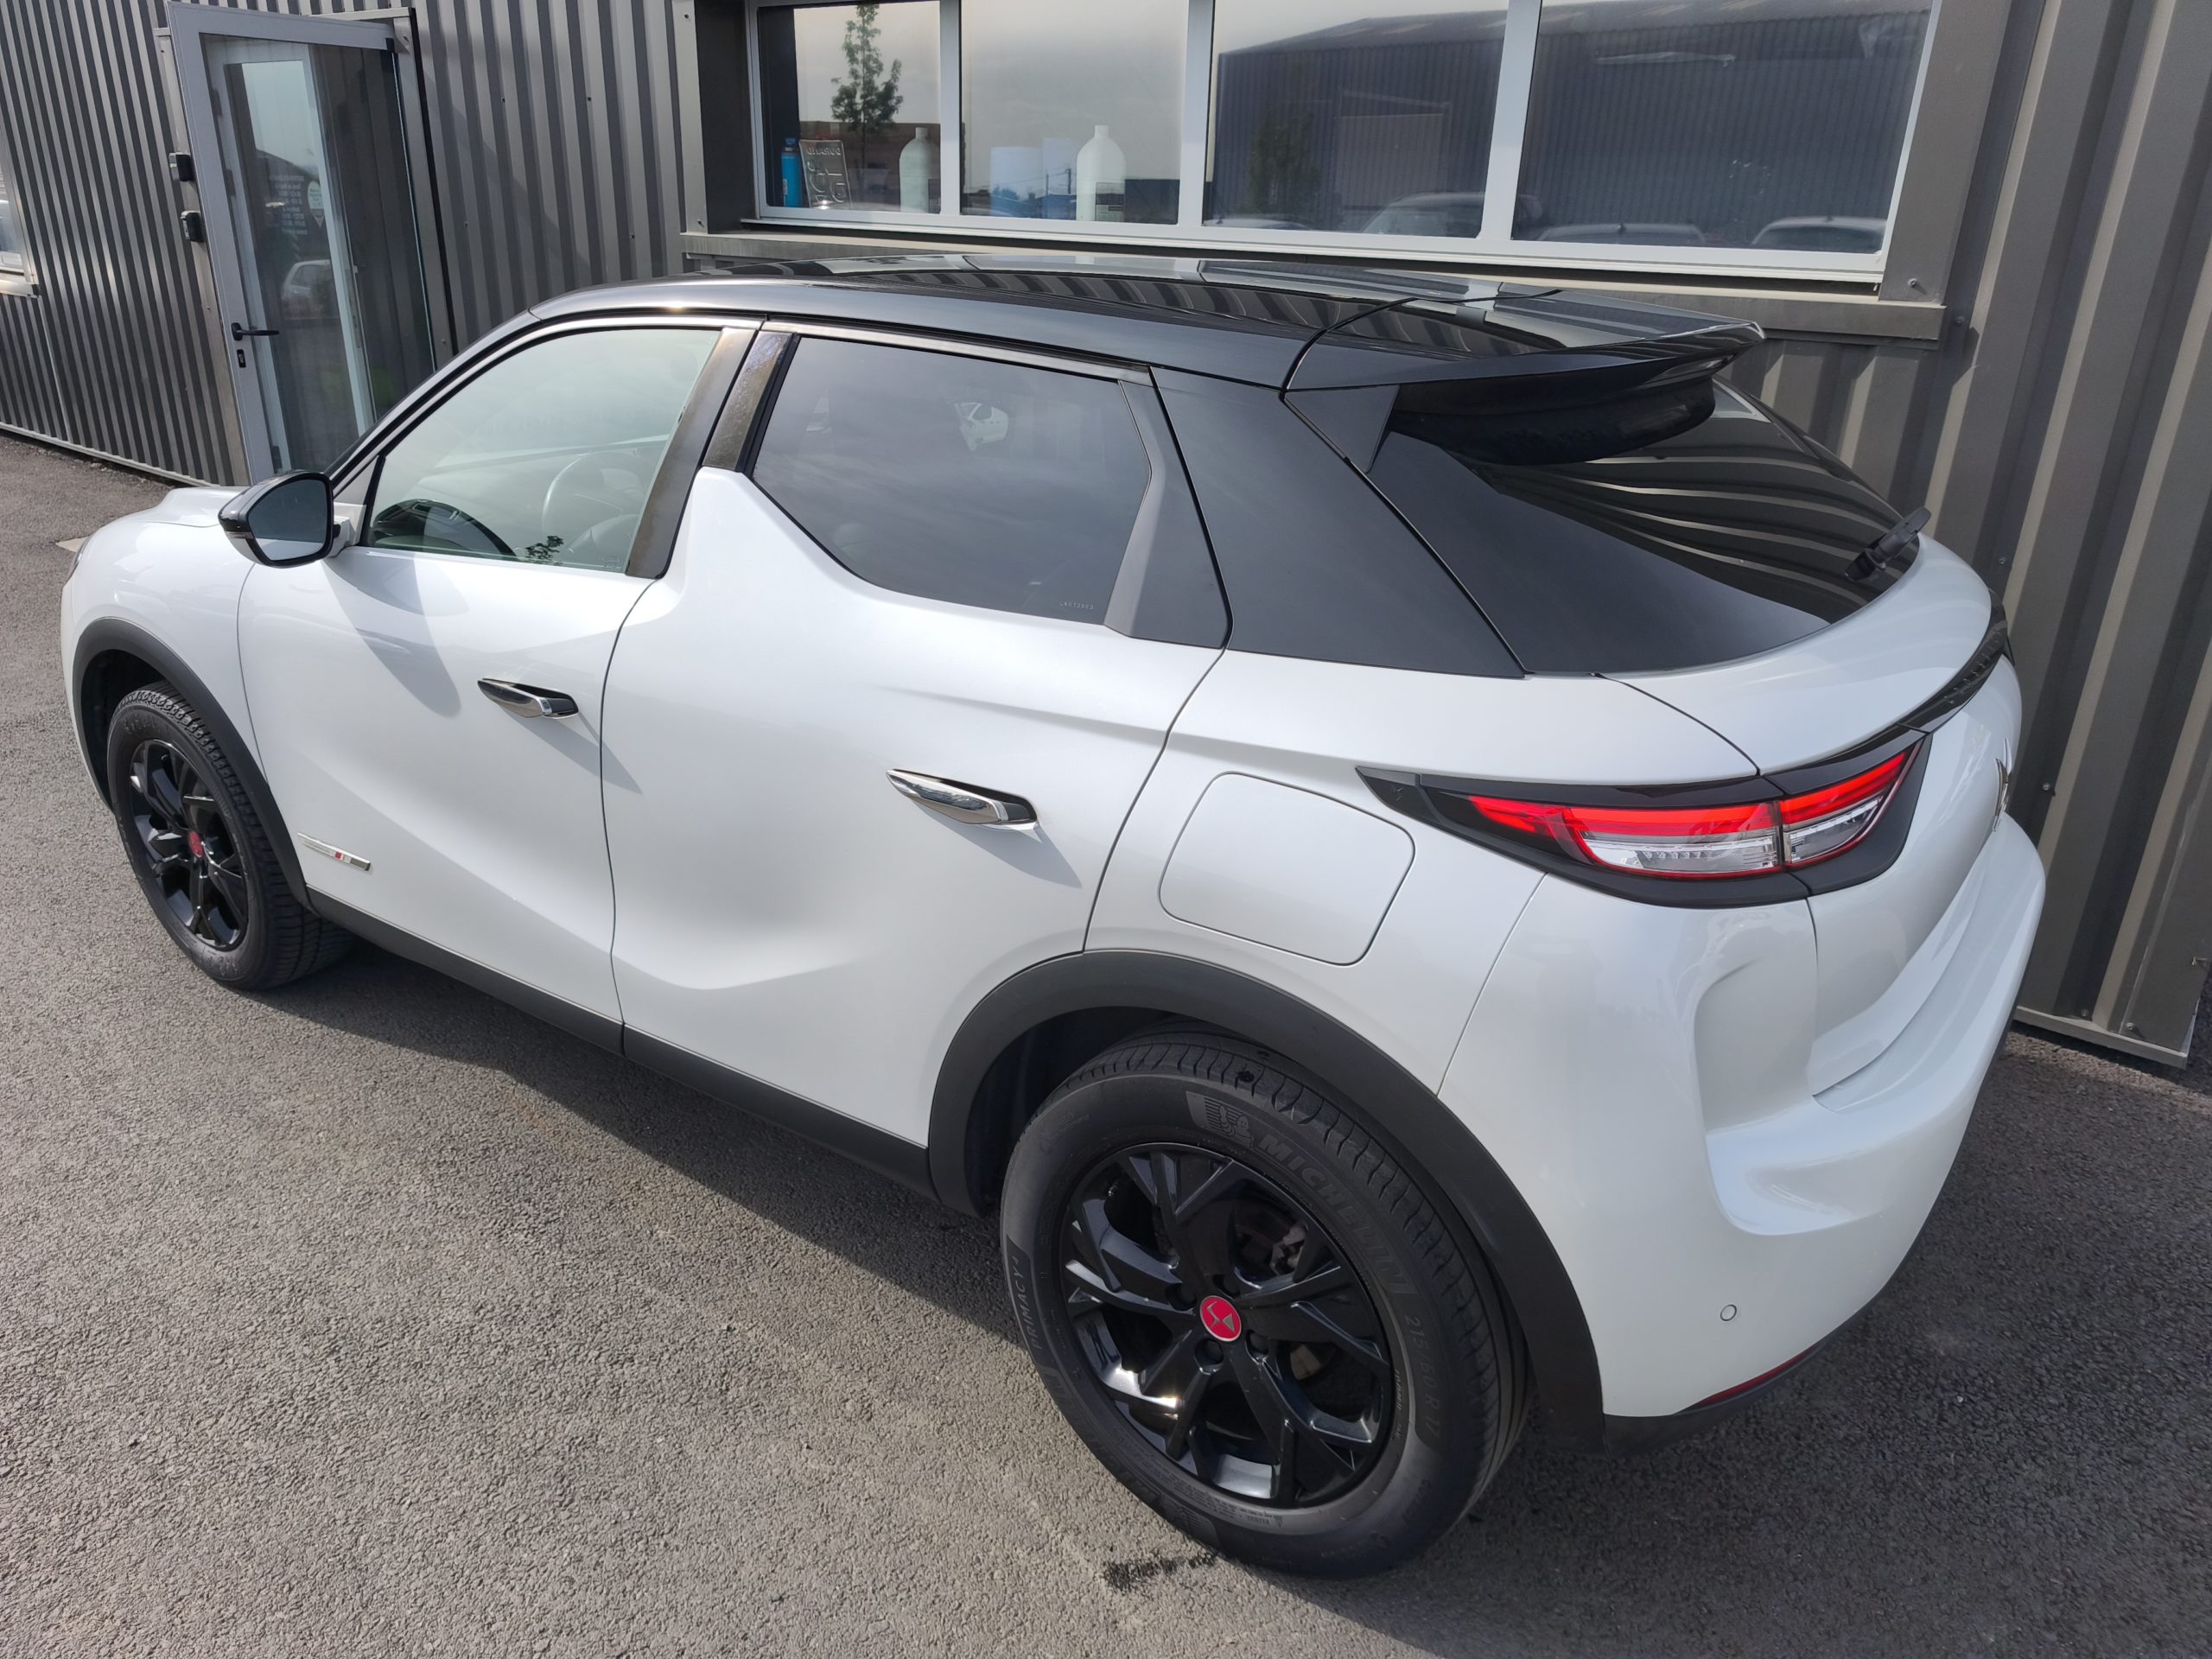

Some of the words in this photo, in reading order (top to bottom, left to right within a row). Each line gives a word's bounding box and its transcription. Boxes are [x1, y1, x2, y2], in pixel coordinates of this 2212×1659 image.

[1259, 1135, 1408, 1287] MICHELIN
[1012, 1266, 1043, 1350] PRIMACY
[1403, 1314, 1437, 1389] 215/60
[1424, 1394, 1440, 1409] R
[1425, 1415, 1440, 1438] 17
